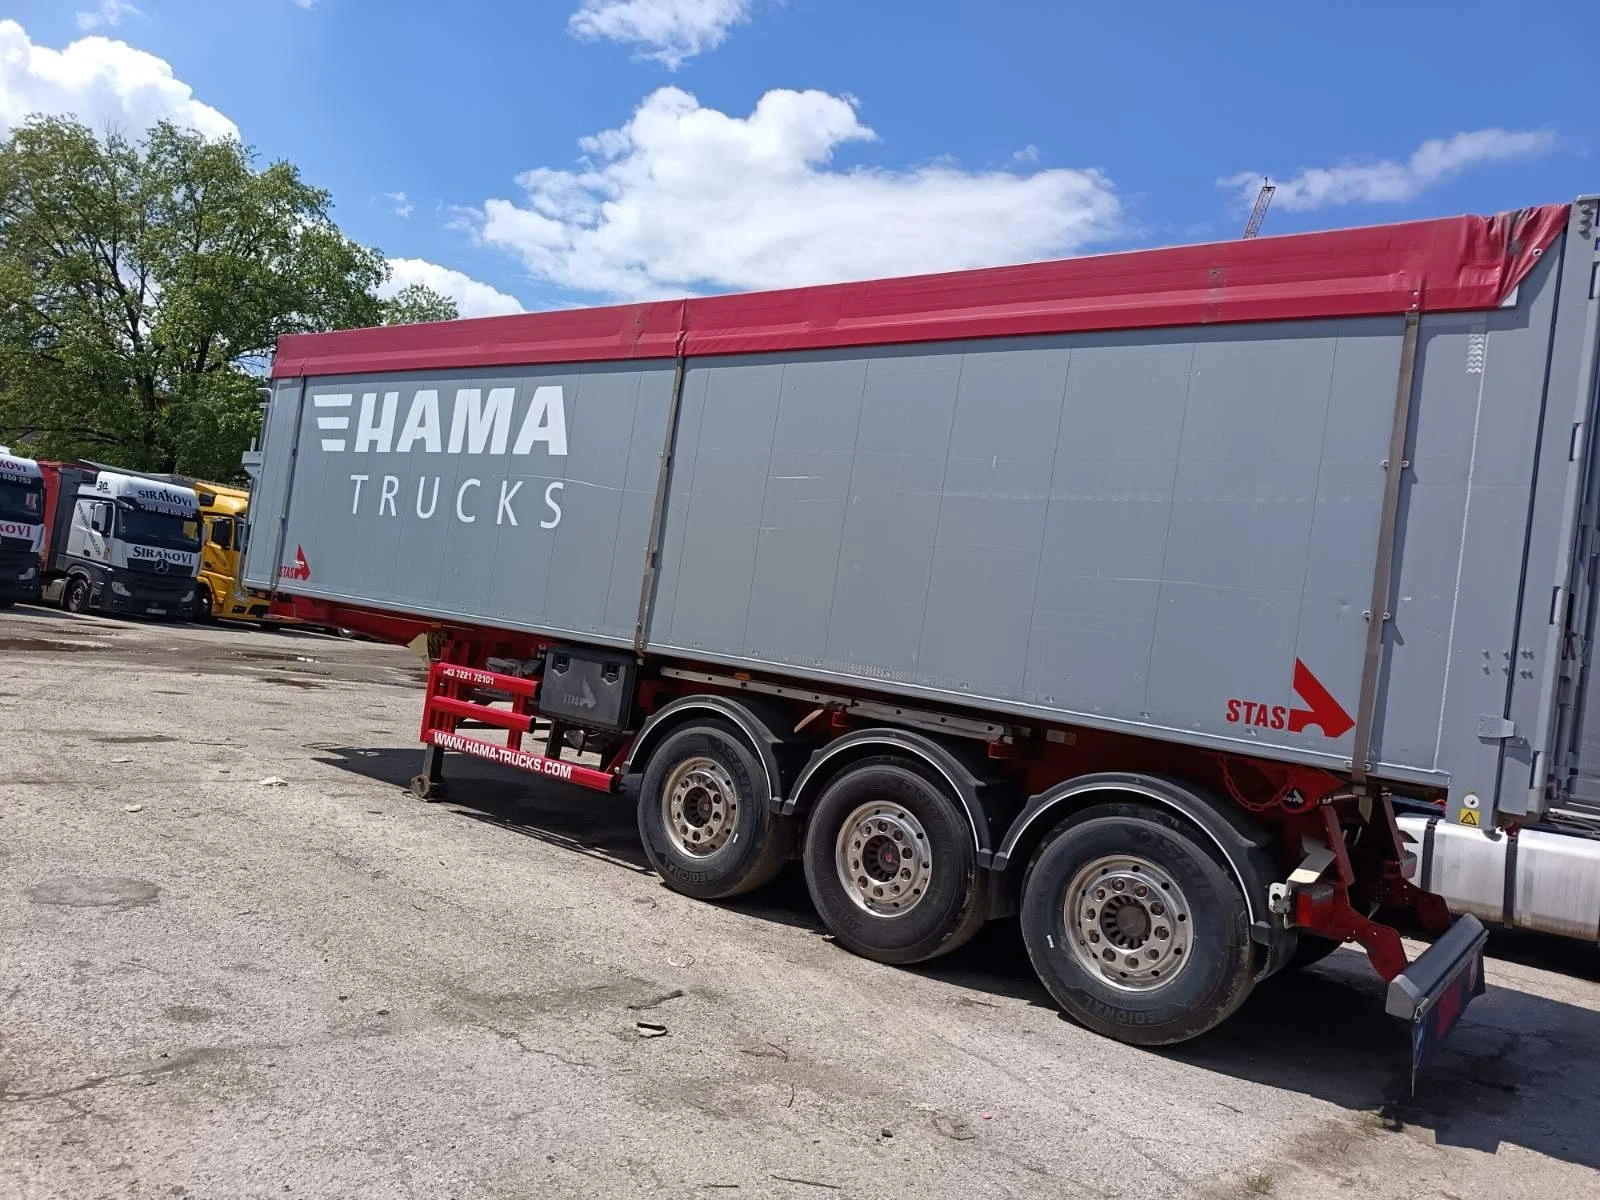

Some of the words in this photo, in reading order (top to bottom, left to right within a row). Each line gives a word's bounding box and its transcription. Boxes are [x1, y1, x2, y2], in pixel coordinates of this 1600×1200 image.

[138, 490, 192, 508] SIRAKOVI
[350, 474, 564, 529] TRUCKS
[133, 546, 192, 564] SIRAKOVI
[443, 668, 455, 677] +43
[456, 670, 472, 680] 7221
[473, 673, 495, 685] 72101
[1226, 699, 1286, 730] STAS
[434, 731, 572, 779] WWW.HAMA-TRUCKS.COM
